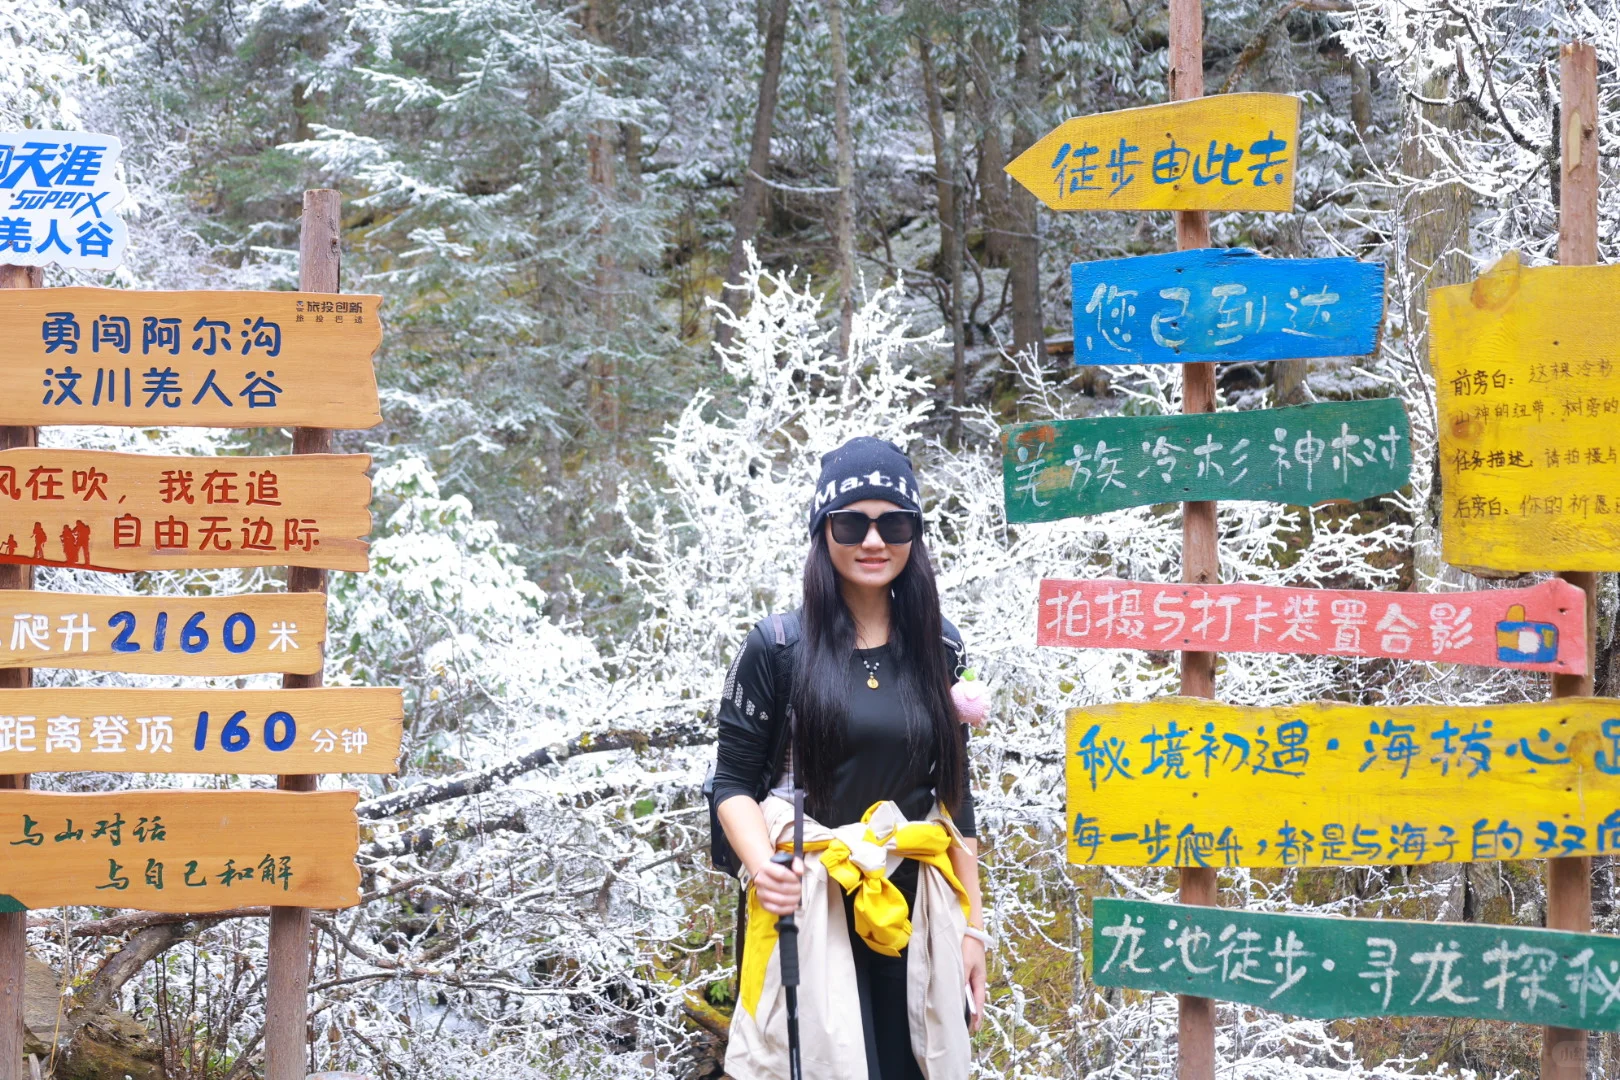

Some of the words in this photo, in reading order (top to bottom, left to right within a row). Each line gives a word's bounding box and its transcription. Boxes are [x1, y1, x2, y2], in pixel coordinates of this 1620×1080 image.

[1051, 130, 1288, 199] 徒步由此去
[307, 301, 363, 313] 旅投创新
[1085, 283, 1341, 353] 您已到达
[42, 311, 282, 356] 勇闯阿尔沟
[42, 366, 283, 409] 汶川羌人谷
[1014, 423, 1400, 506] 羌族冷杉神树
[113, 513, 320, 553] 自由无边际
[0, 610, 300, 654] 爬升2160米
[1046, 588, 1473, 655] 拍摄与打卡装置合影
[9, 812, 167, 847] 与山对话
[95, 853, 294, 892] 与自己和解
